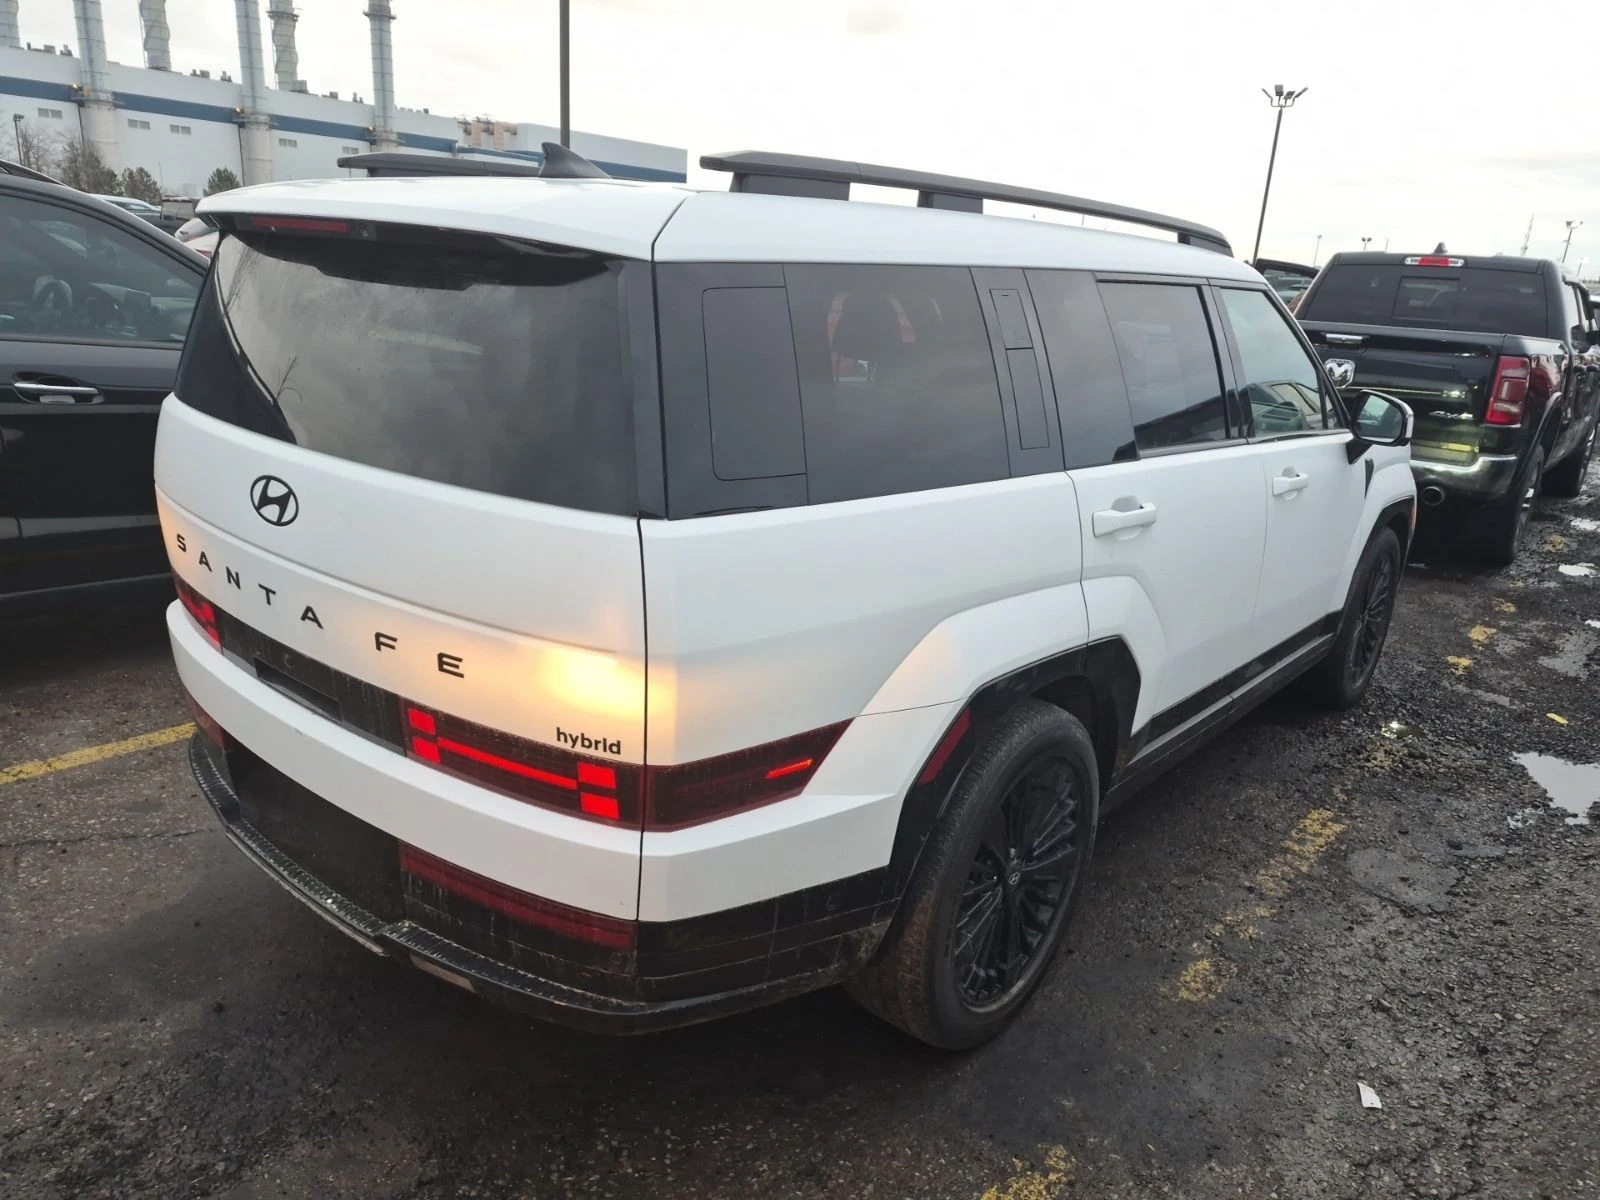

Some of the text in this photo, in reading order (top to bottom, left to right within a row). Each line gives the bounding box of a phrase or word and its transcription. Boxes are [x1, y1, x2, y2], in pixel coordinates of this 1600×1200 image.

[176, 533, 465, 679] SANTA FE
[556, 726, 621, 755] hybrid
